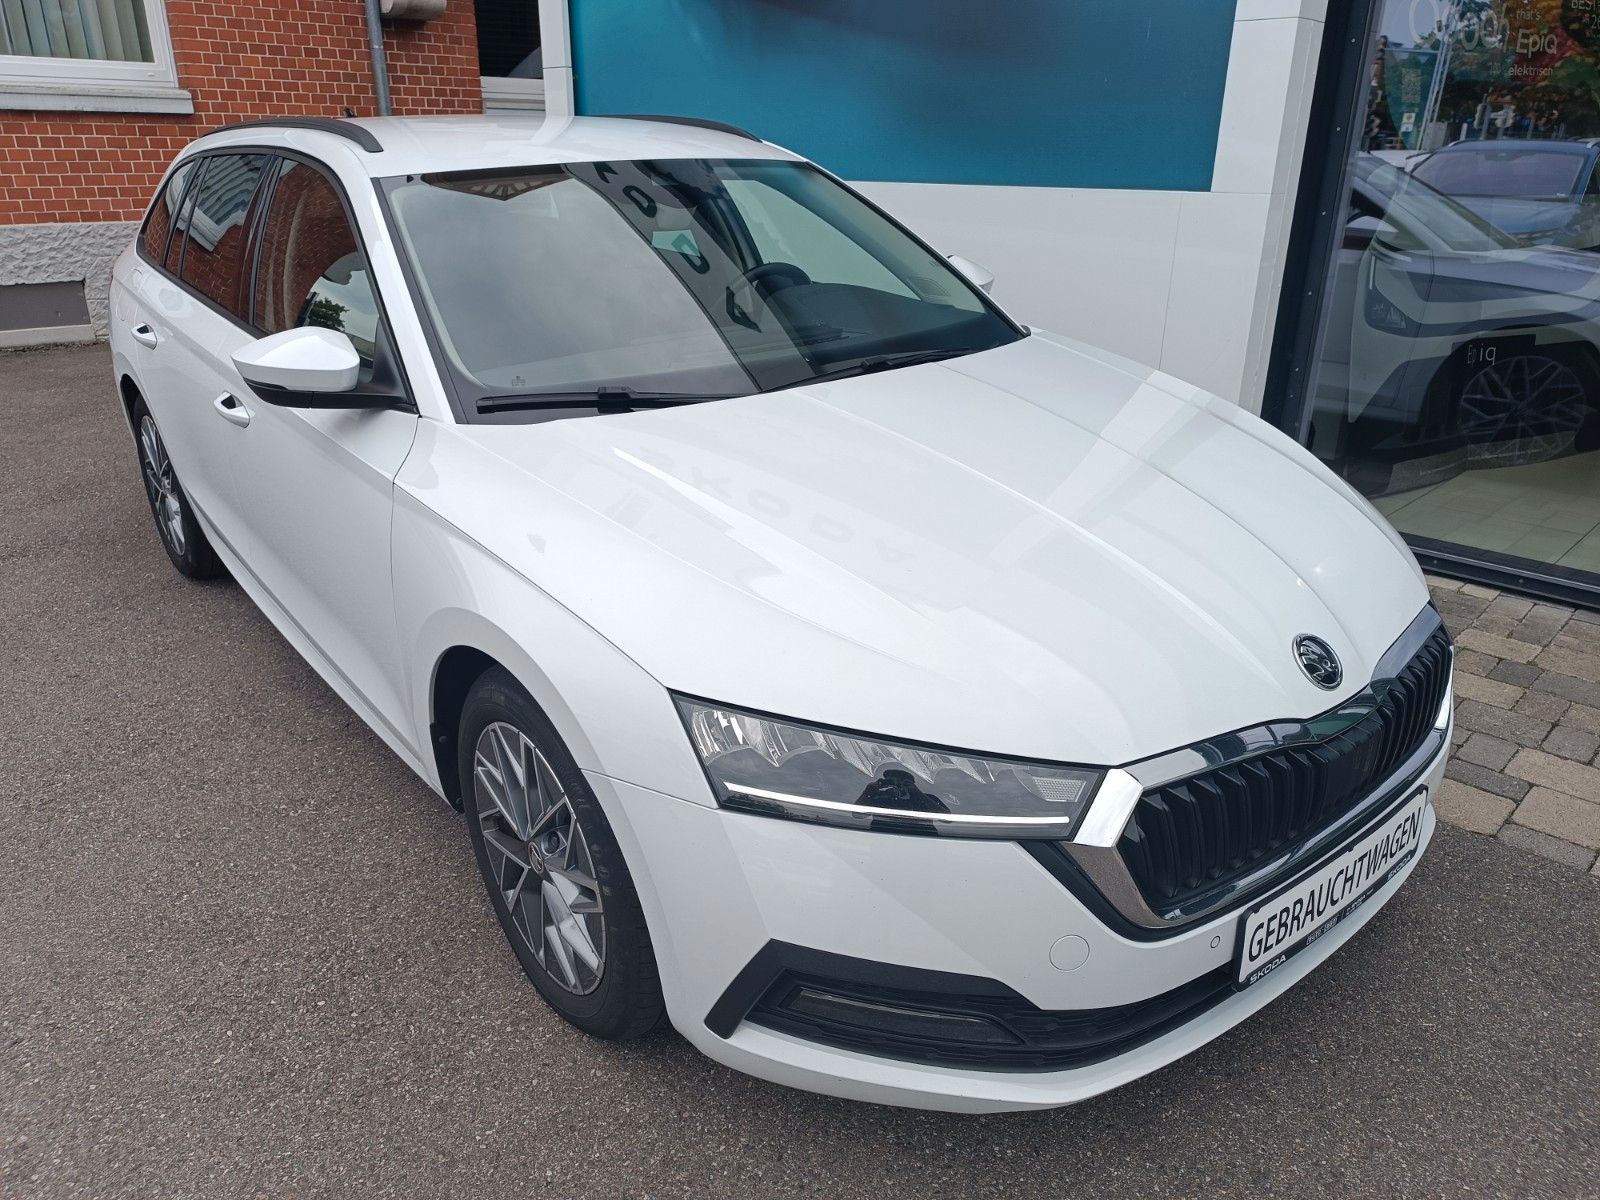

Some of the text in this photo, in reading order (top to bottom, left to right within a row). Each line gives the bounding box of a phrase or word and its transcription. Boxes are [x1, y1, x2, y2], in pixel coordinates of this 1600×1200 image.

[1508, 64, 1553, 76] elektrisch
[1249, 806, 1422, 963] GEBRAUCHTWAGEN
[1249, 954, 1287, 984] SKODA
